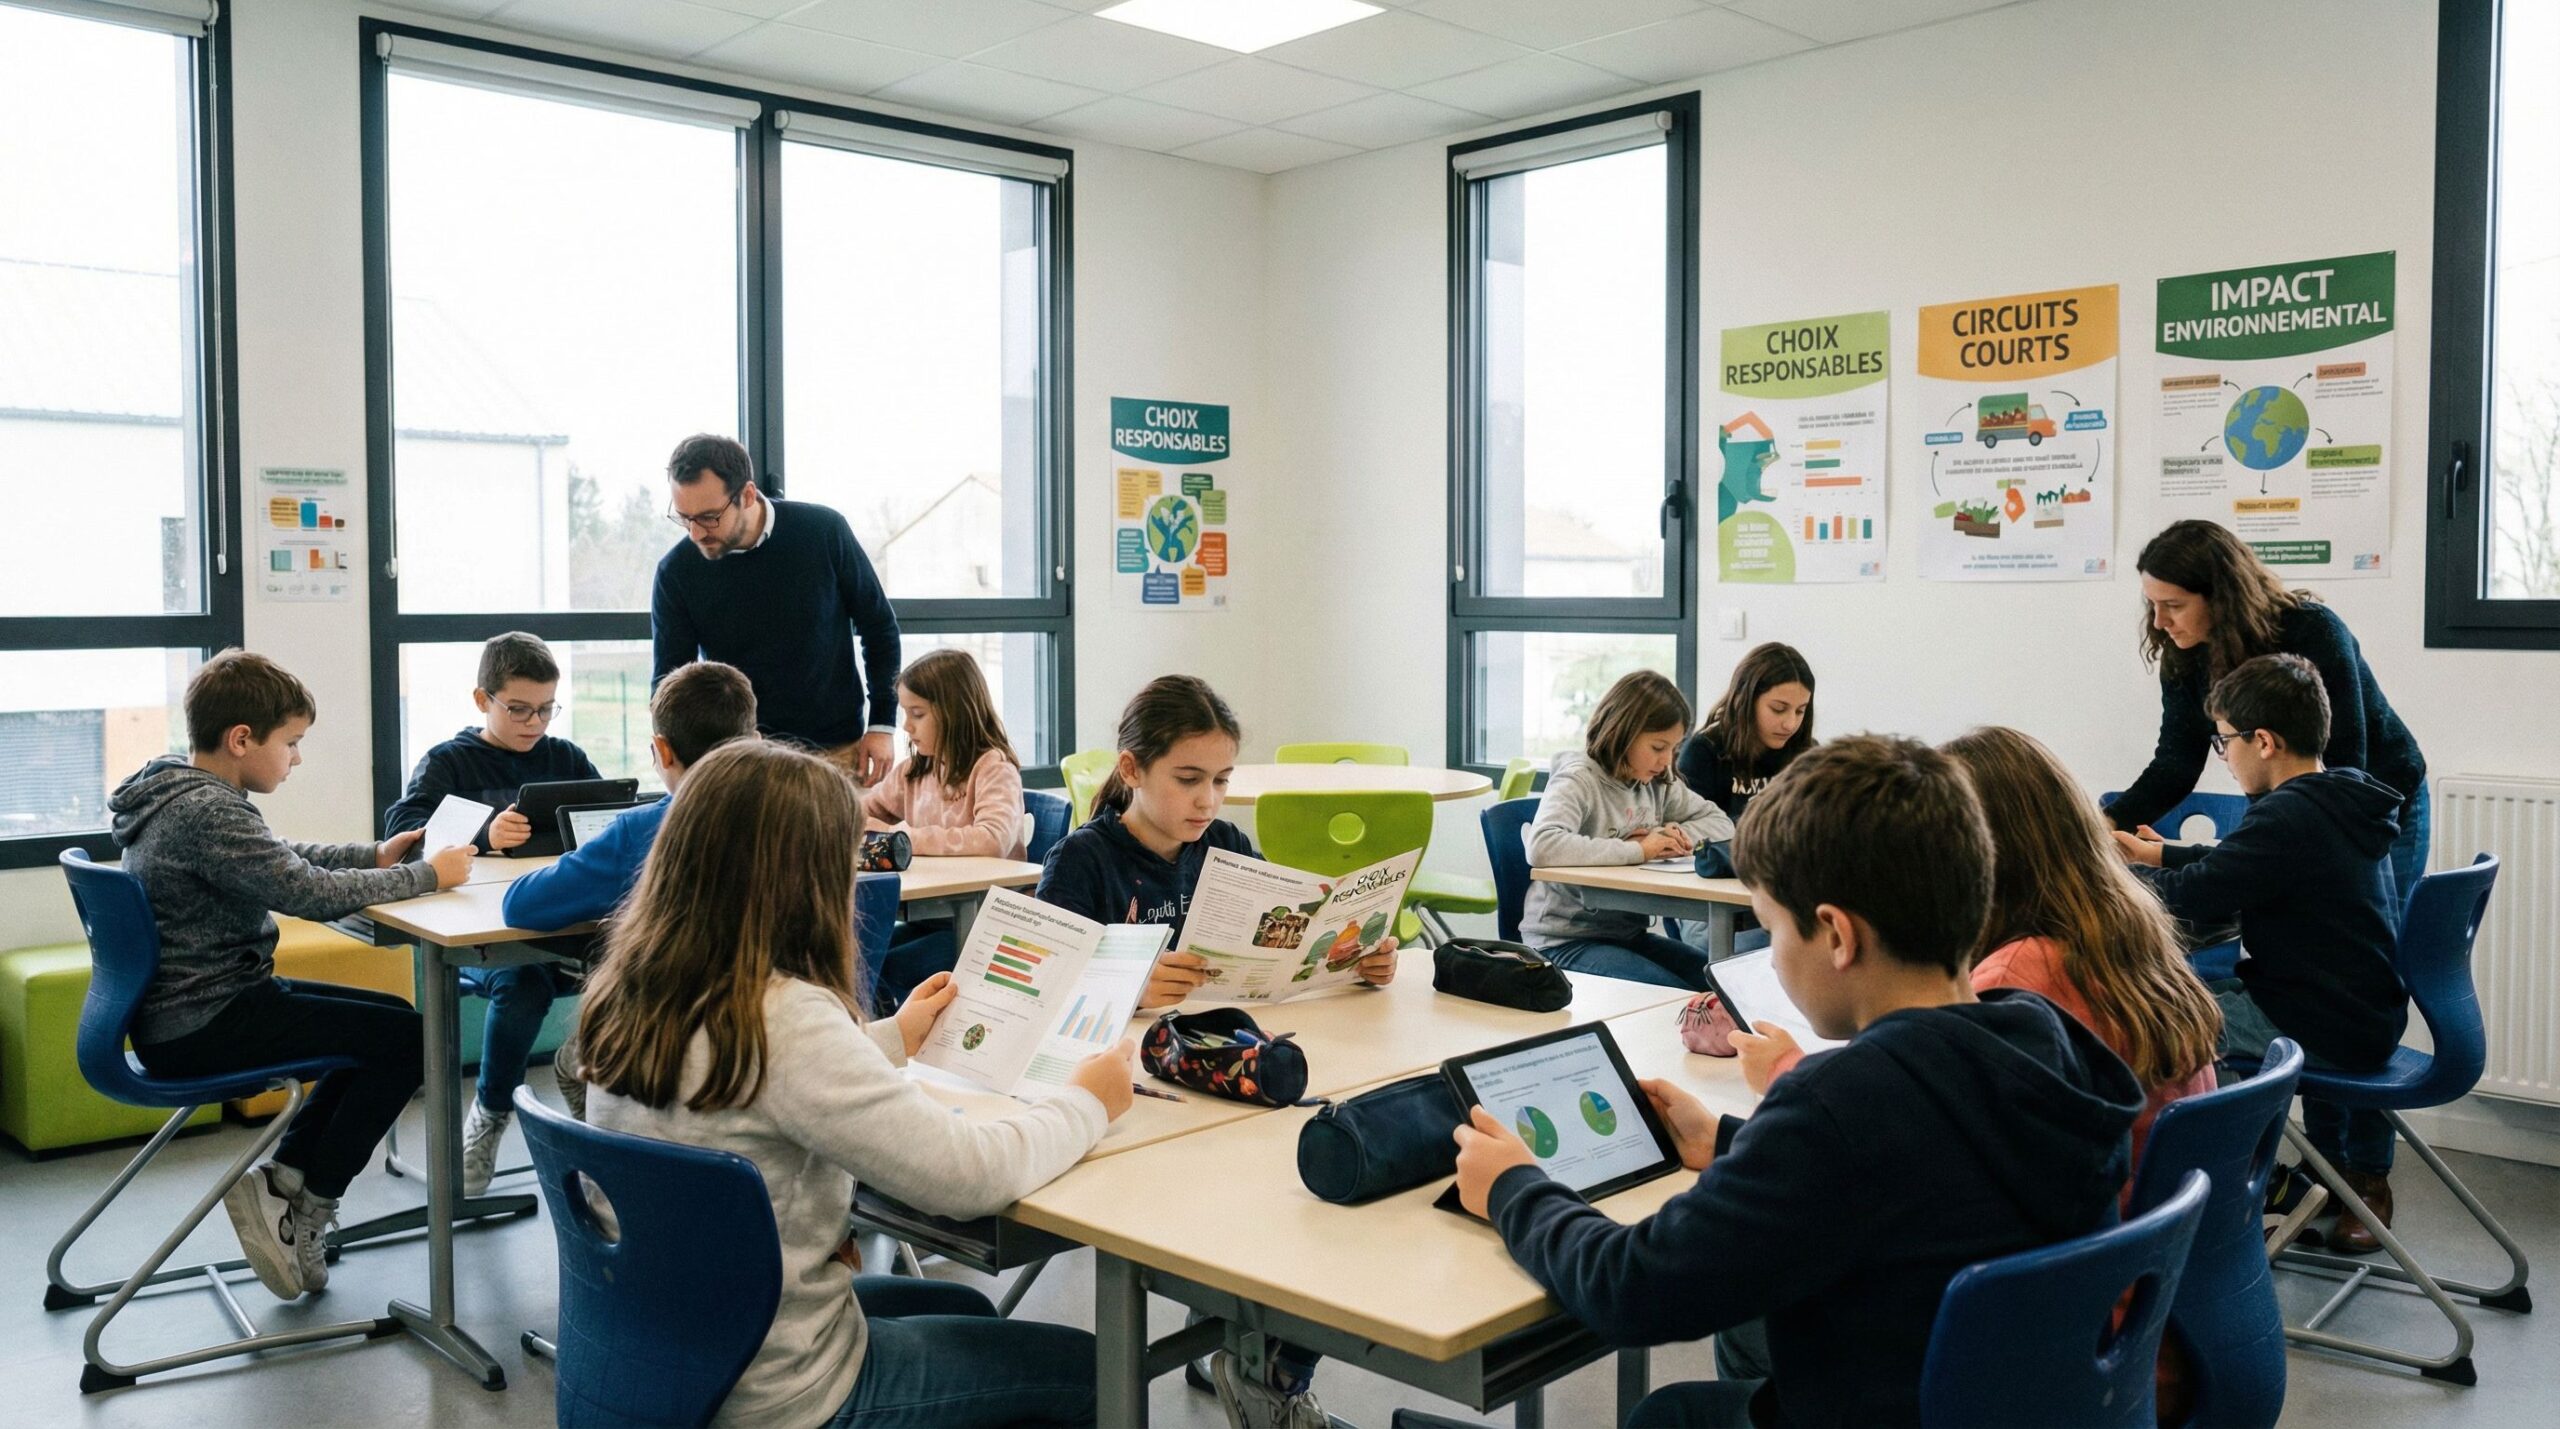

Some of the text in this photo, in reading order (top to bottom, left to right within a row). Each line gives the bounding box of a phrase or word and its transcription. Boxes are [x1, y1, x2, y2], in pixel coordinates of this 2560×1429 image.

[2211, 269, 2334, 311] IMPACT
[1952, 298, 2079, 337] CIRCUITS
[2163, 301, 2387, 343] ENVIRONNEMENTAL
[1766, 324, 1839, 355] CHOIX
[1960, 333, 2070, 368] COURTS
[1726, 351, 1883, 386] RESPONSABLES
[1145, 406, 1198, 429] CHOIX
[1115, 428, 1226, 453] RESPONSABLES
